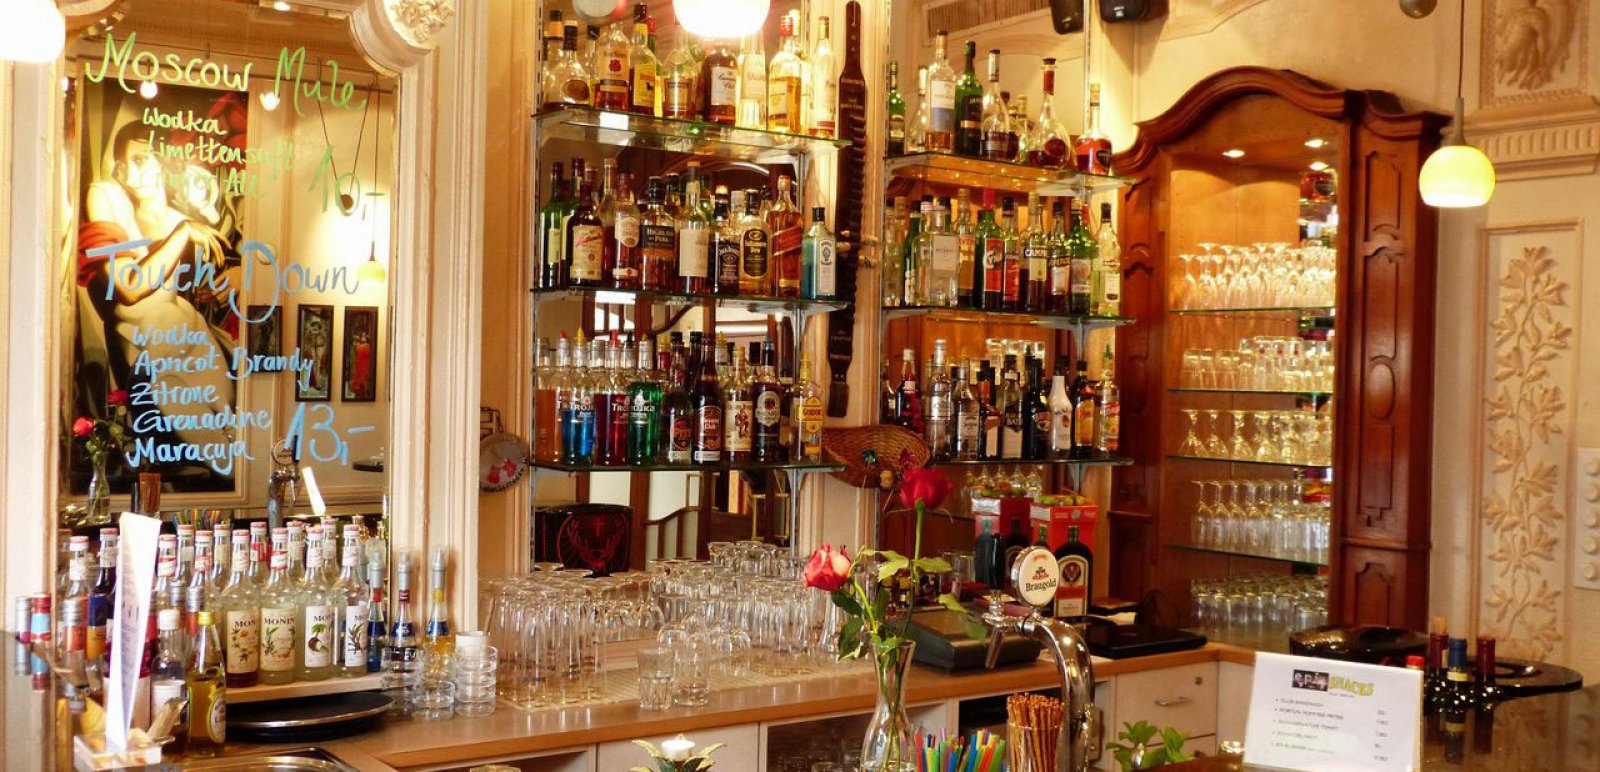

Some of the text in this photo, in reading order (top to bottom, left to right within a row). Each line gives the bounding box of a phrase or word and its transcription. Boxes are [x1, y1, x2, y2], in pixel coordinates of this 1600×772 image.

[85, 31, 368, 117] Moscow Mule
[143, 107, 227, 135] Wodka
[85, 238, 359, 324] Touch Down
[132, 323, 214, 347] Wodka
[134, 346, 315, 393] Apricot Brandy
[130, 383, 220, 406] Zitrone
[132, 406, 273, 434] Grenadine
[284, 402, 376, 467] 13,-
[125, 436, 256, 477] Maracuja
[1025, 579, 1057, 593] Braugold
